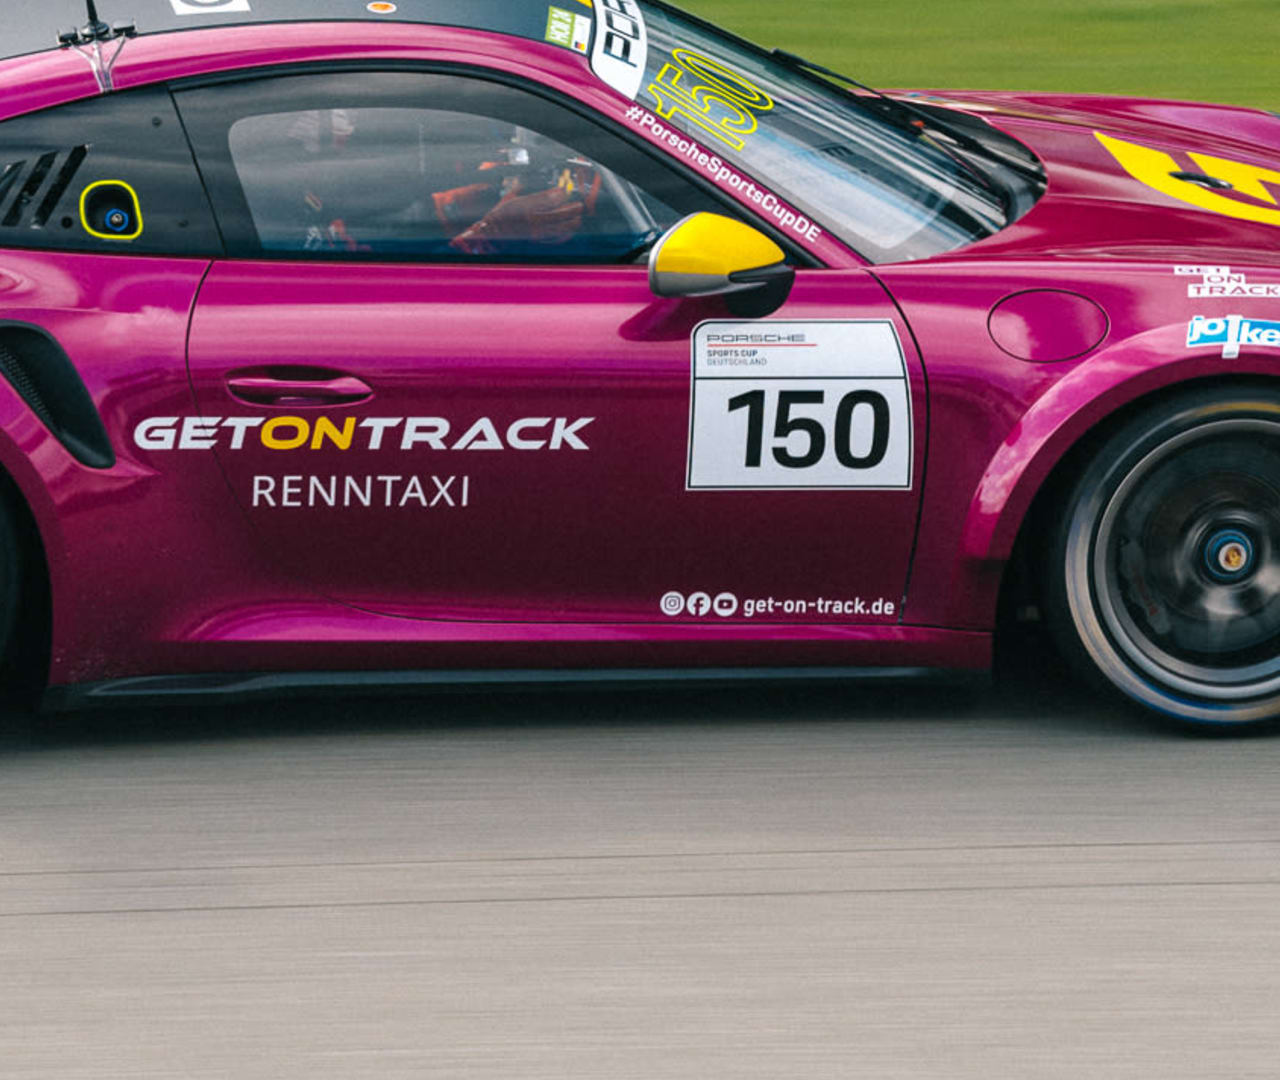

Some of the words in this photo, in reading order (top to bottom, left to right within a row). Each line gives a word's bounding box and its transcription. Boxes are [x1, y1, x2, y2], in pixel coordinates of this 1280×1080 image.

[648, 48, 774, 151] 150
[625, 106, 821, 243] #PorscheSportsCupDE
[1207, 275, 1242, 284] ON
[1192, 286, 1279, 295] TRACK
[707, 334, 806, 343] PORSCHE
[707, 349, 739, 358] SPORTS
[740, 349, 758, 358] CUP
[707, 358, 768, 367] DEUTSCHLAND
[133, 416, 596, 450] GETONTRACK
[728, 389, 890, 470] 150
[252, 475, 469, 507] RENNTAXI
[743, 596, 895, 617] get-on-track.de
